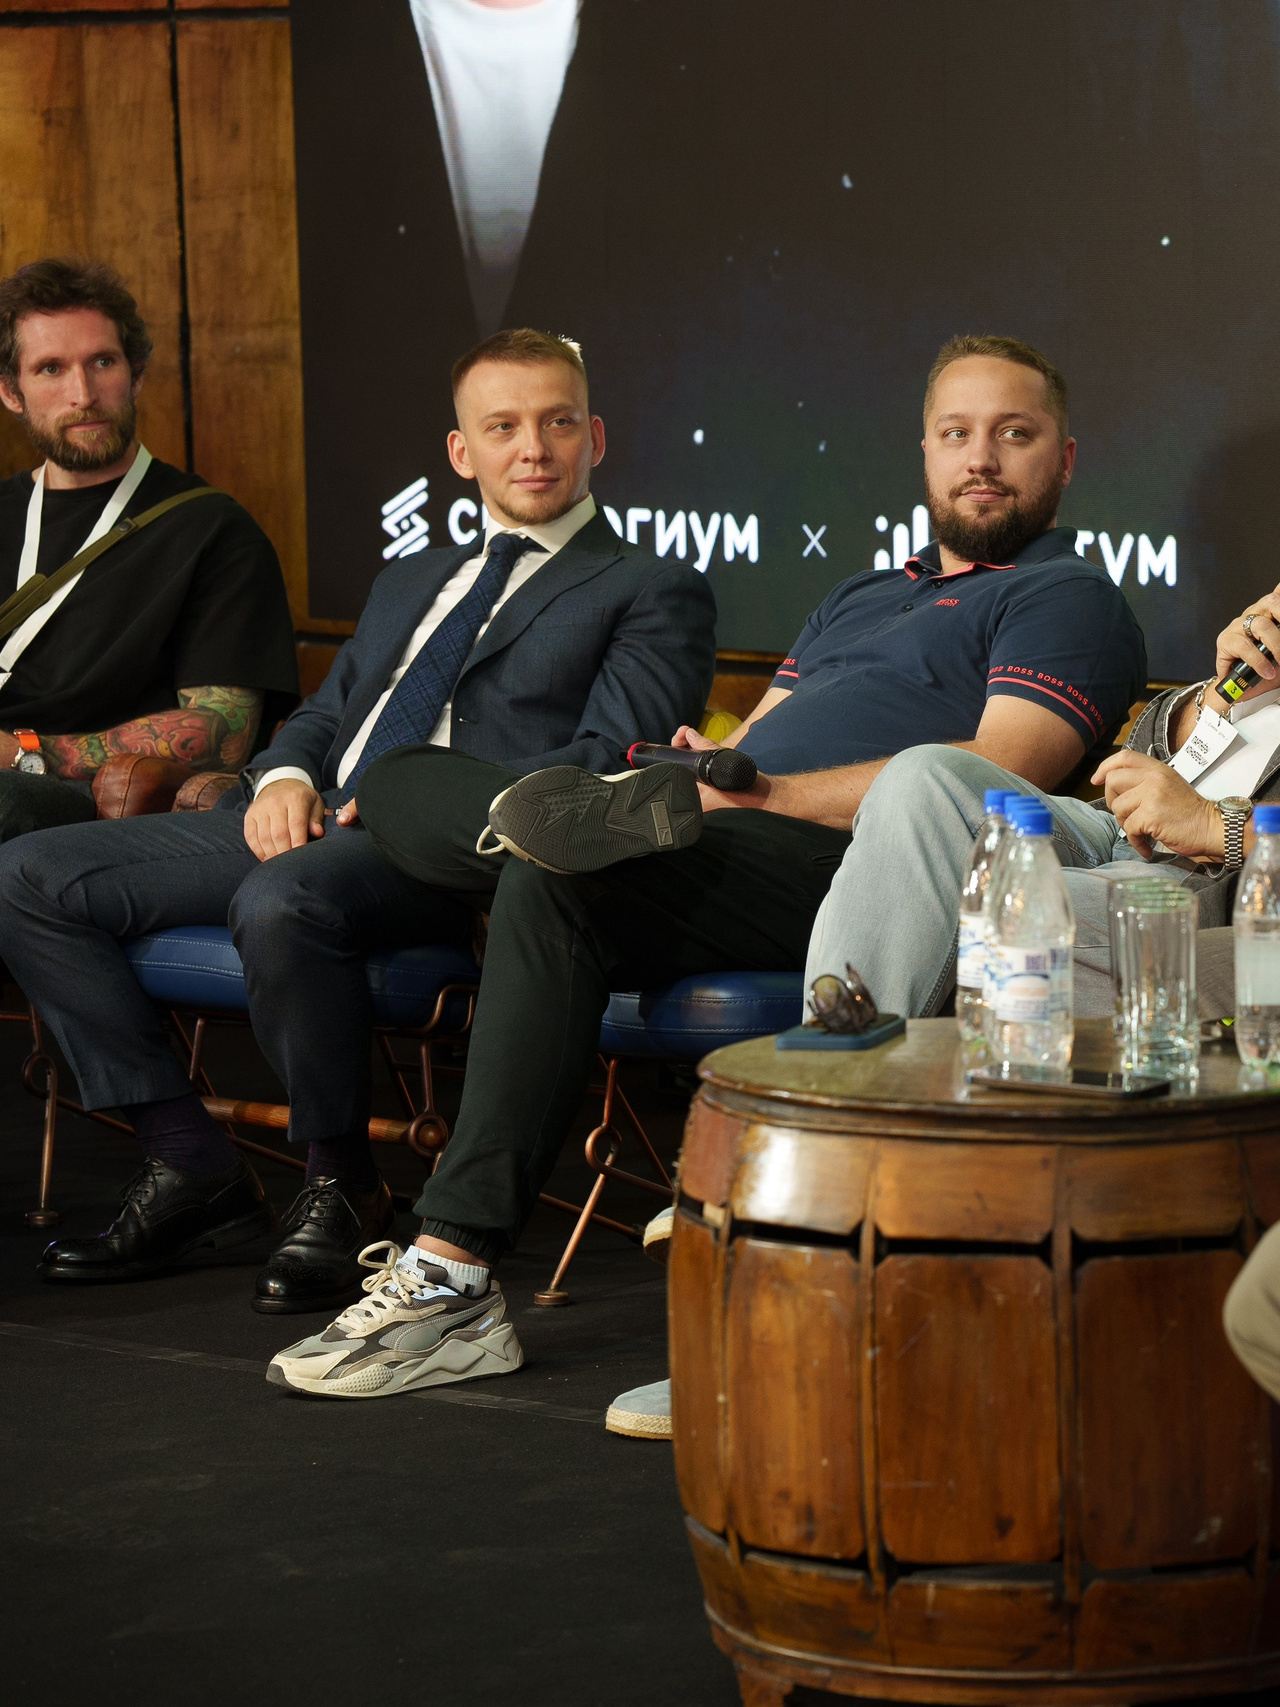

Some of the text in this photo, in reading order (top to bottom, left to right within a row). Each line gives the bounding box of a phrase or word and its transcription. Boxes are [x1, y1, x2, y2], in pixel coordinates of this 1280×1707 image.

[1007, 665, 1034, 676] BOSS
[1037, 672, 1064, 687] BOSS
[1066, 685, 1089, 706] BOSS
